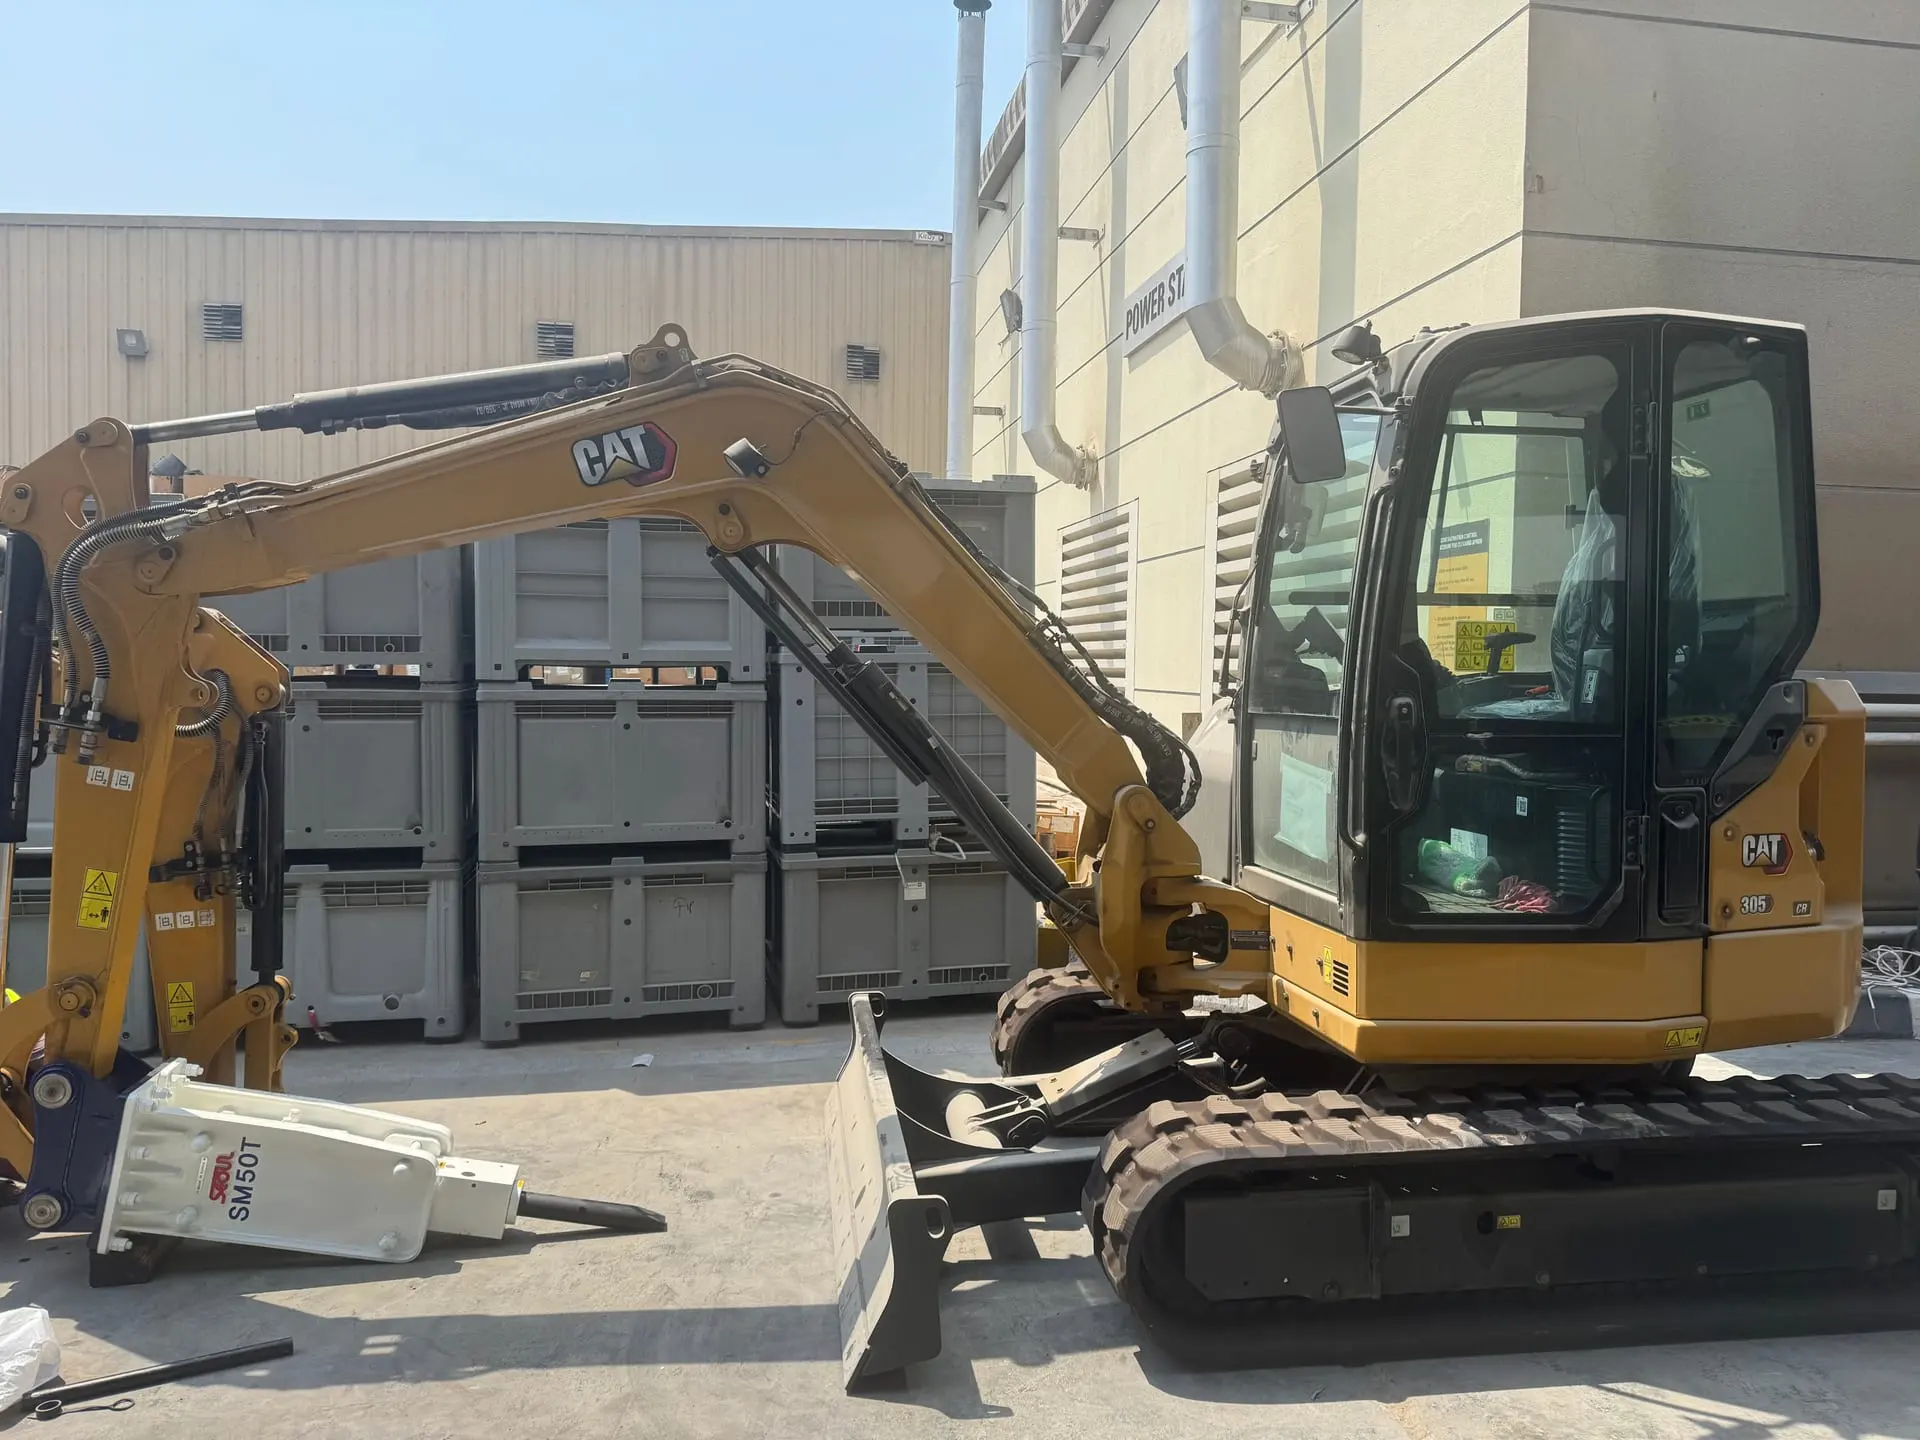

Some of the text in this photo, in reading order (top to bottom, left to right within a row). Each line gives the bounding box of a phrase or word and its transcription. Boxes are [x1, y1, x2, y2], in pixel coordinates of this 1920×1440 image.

[1126, 281, 1165, 341] POWER
[573, 424, 650, 486] CAT
[1742, 834, 1781, 867] CAT
[1741, 895, 1766, 914] 305
[1796, 903, 1808, 914] CR
[228, 1136, 262, 1222] SM50T
